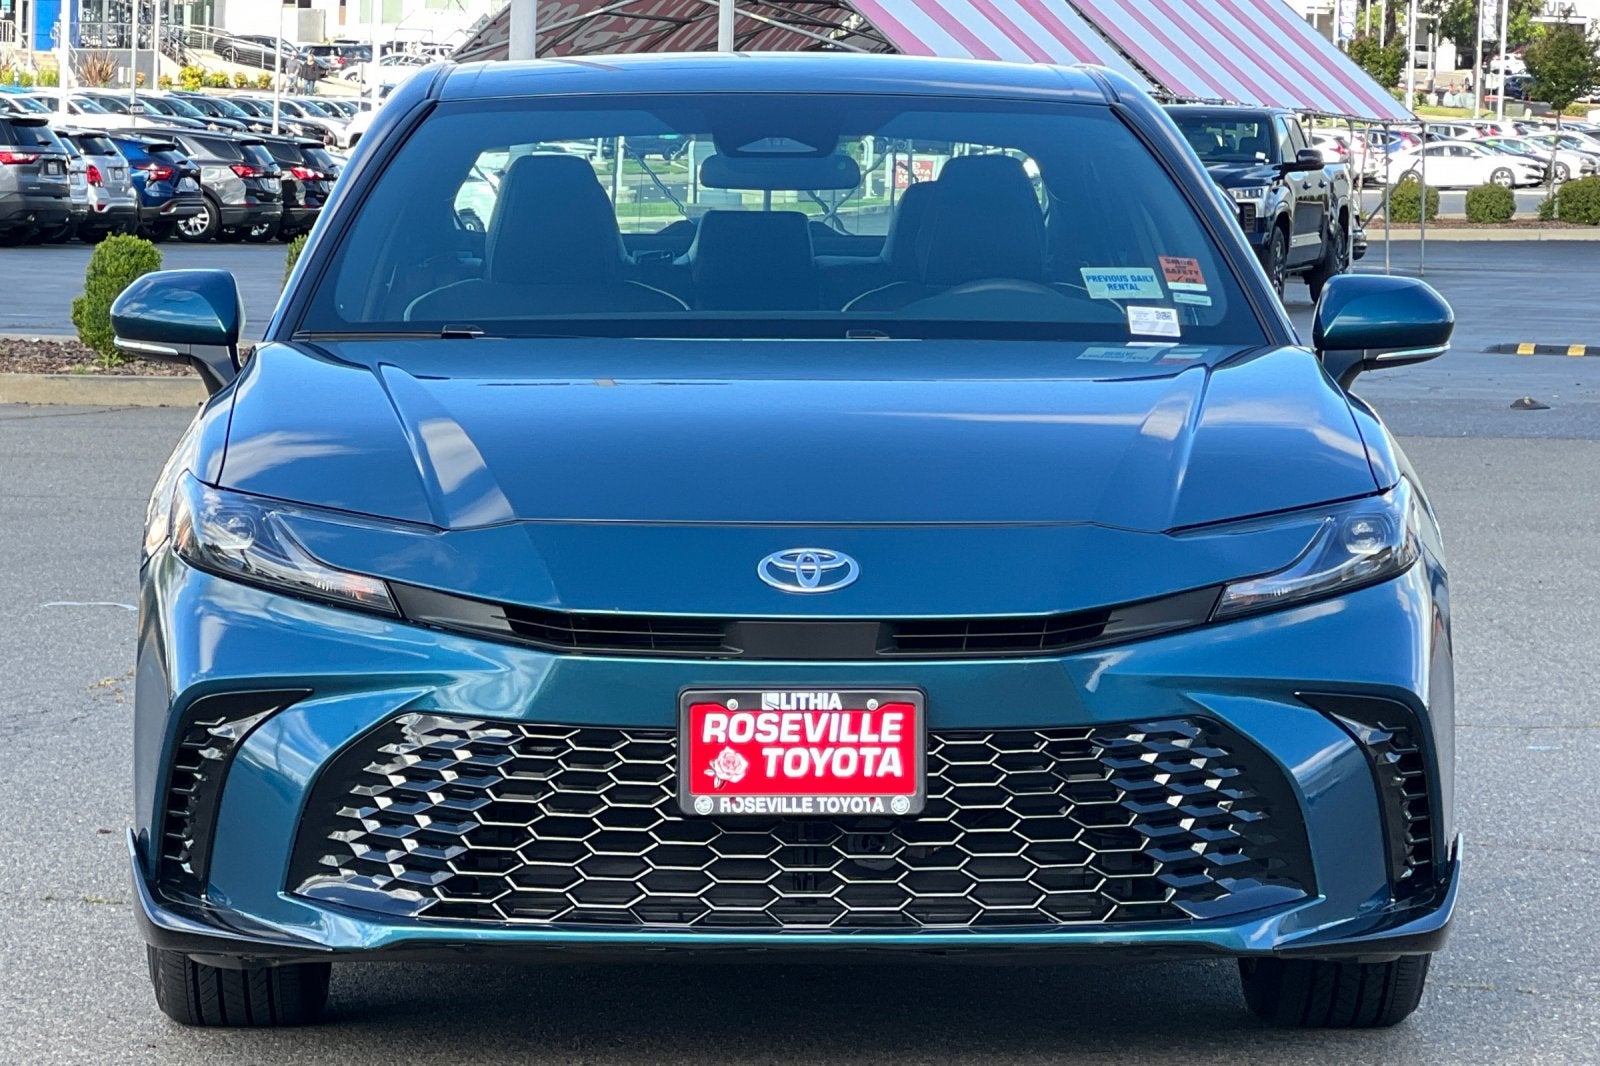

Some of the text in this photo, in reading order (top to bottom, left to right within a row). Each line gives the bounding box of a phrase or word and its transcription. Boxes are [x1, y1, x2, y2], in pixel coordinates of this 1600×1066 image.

[1086, 274, 1154, 283] PREVIOUS DAILY
[1107, 283, 1141, 291] RENTAL
[780, 692, 842, 710] LITHIA
[702, 713, 903, 743] ROSEVILLE
[762, 747, 903, 777] TOYOTA
[719, 797, 884, 813] ROSEVILLE TOYOTA
